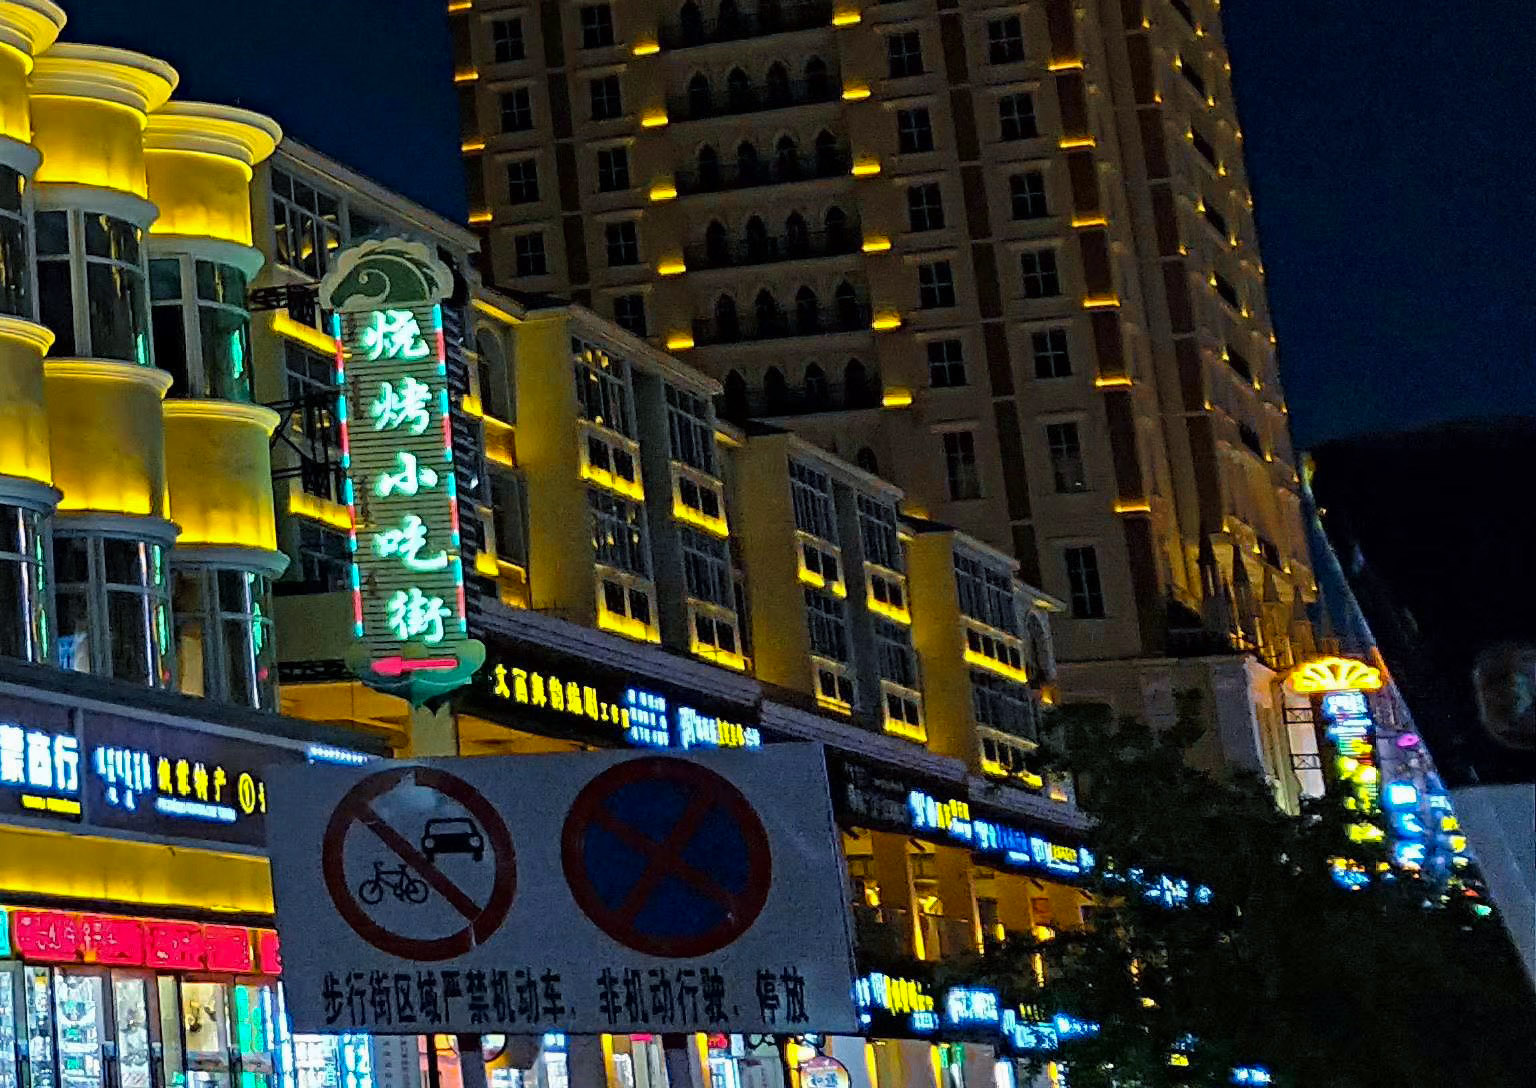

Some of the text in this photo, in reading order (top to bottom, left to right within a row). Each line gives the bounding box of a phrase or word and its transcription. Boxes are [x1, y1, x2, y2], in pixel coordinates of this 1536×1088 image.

[363, 310, 451, 644] 烧烤小吃街
